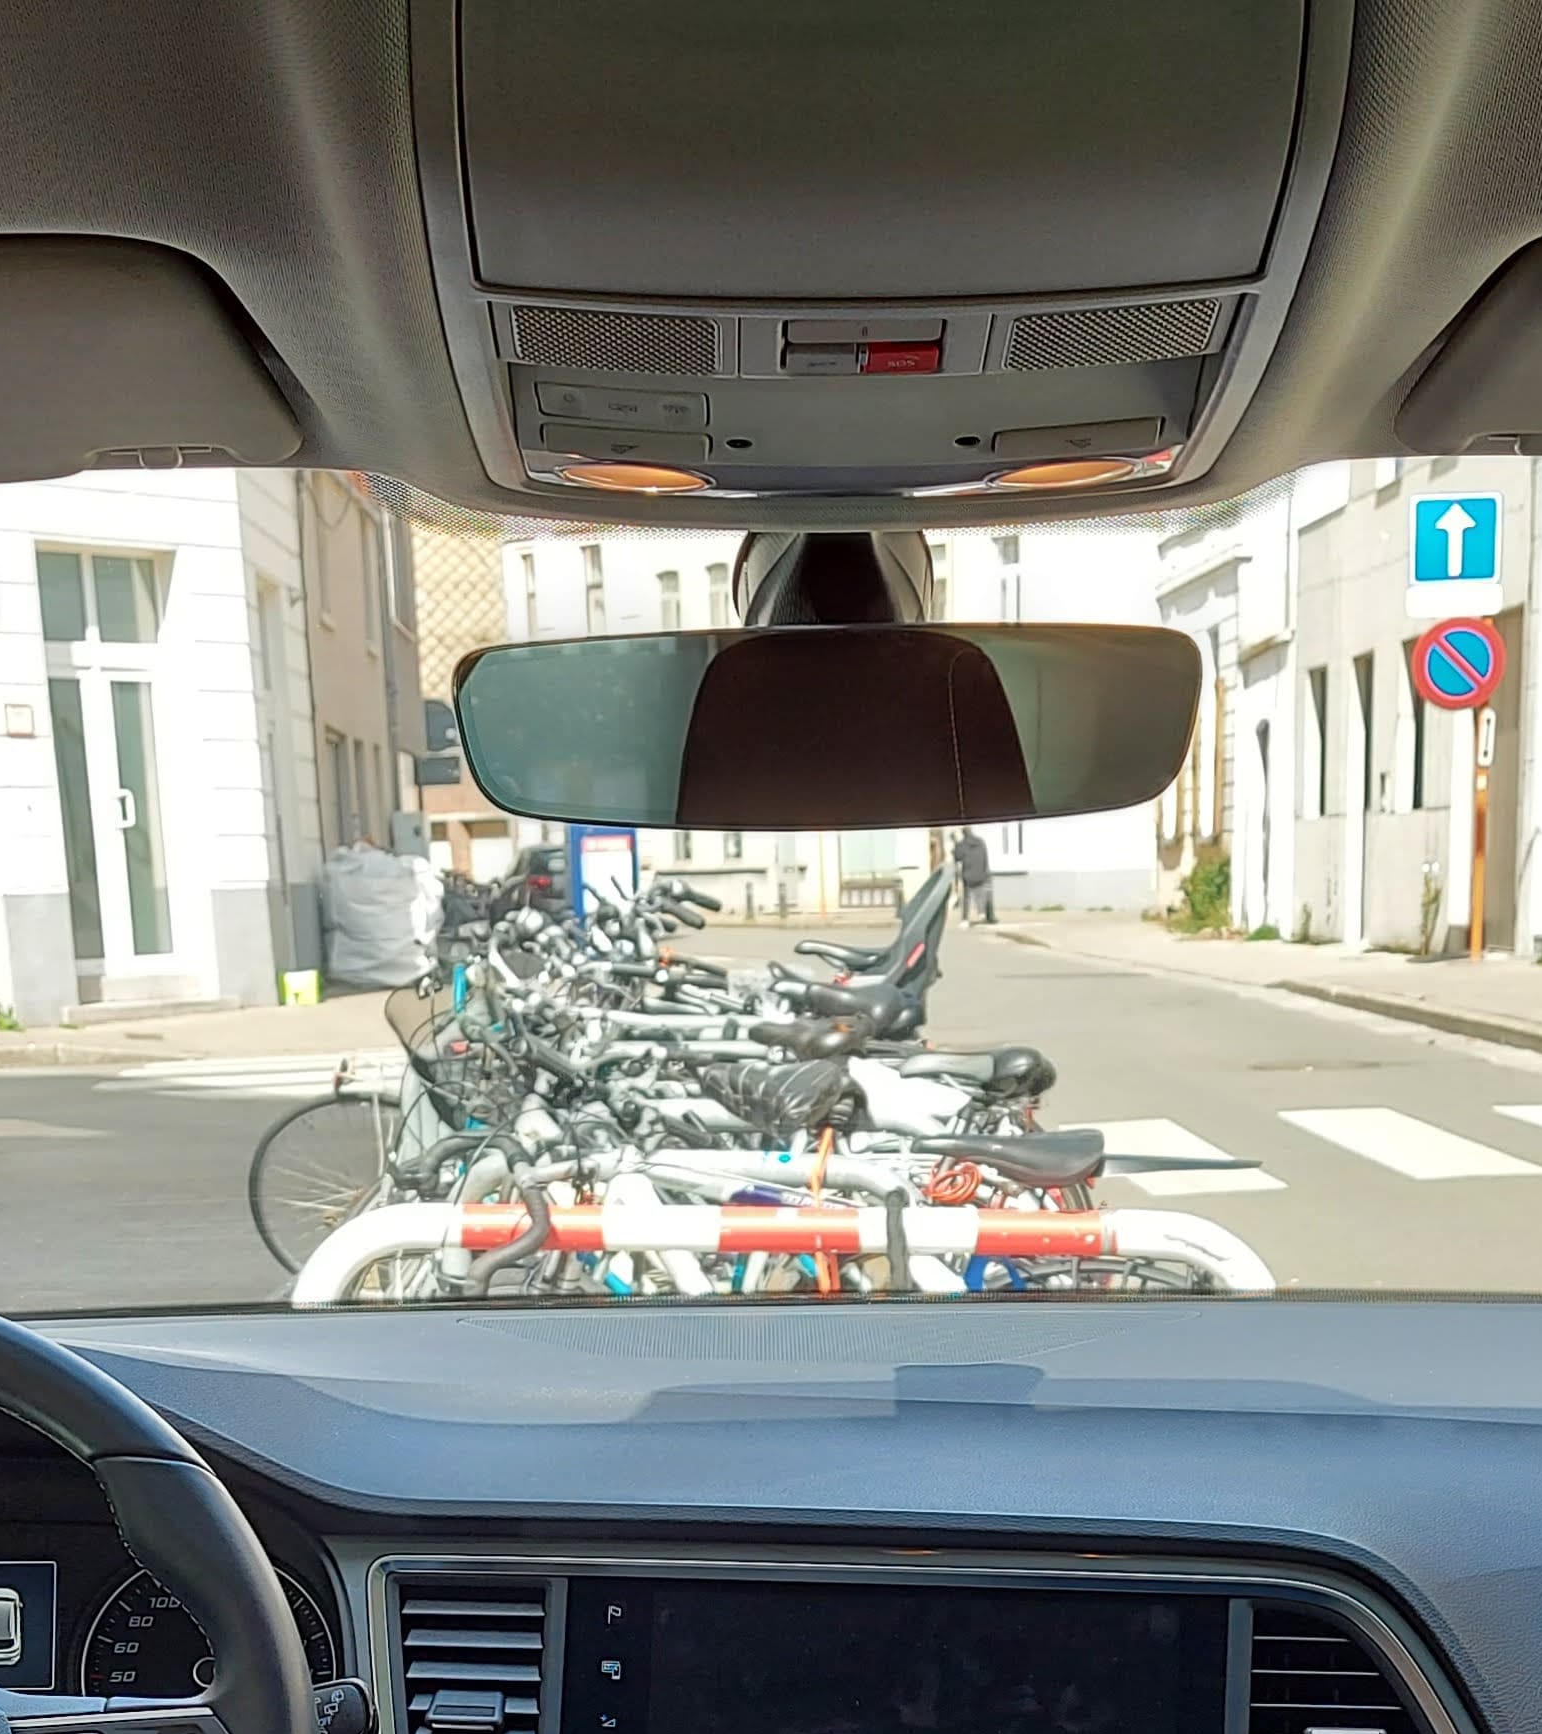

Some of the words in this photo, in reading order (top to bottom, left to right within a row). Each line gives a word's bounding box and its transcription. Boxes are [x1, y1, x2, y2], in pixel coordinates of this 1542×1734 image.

[128, 1616, 154, 1628] 80
[113, 1642, 140, 1654] 60
[110, 1671, 137, 1683] 50
